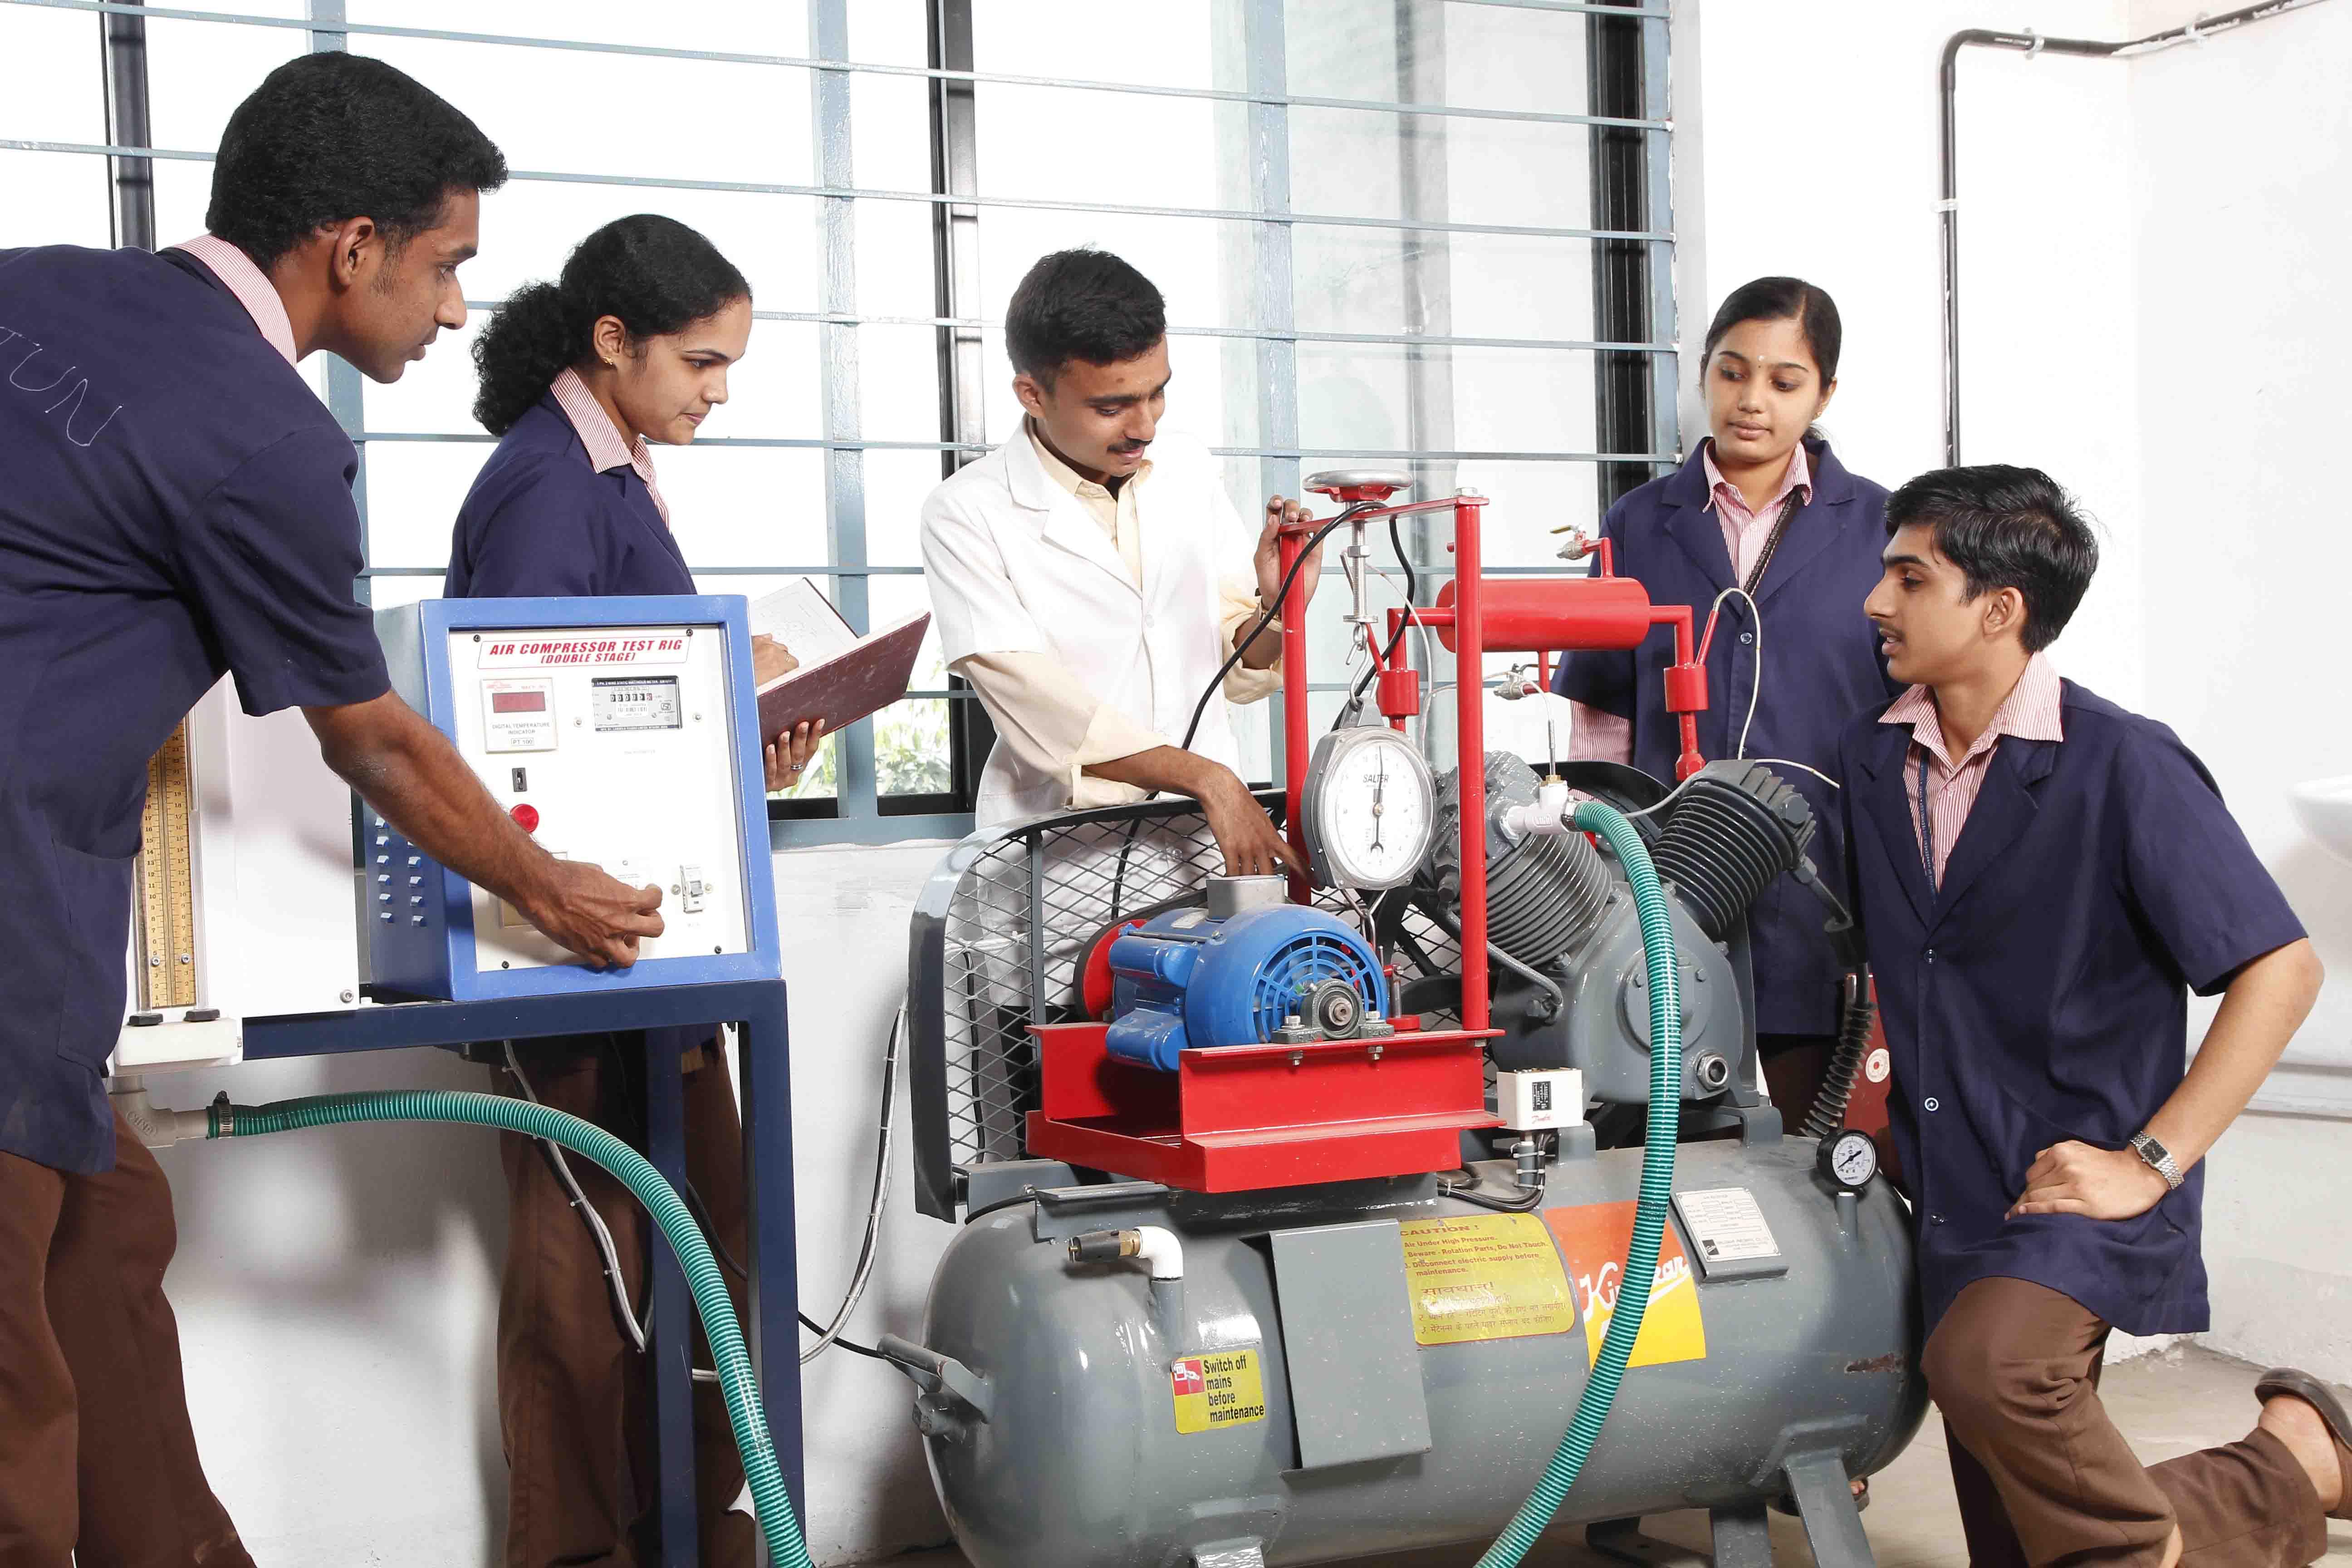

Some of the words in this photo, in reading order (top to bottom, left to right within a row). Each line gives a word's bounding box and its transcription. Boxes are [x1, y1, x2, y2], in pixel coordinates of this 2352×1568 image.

[490, 644, 515, 655] AIR
[519, 641, 615, 655] COMPRESSOR
[622, 640, 654, 652] TEST
[658, 639, 683, 650] RIG
[1362, 774, 1389, 783] SALTER
[1400, 1225, 1470, 1236] CAUTION
[1441, 1238, 1460, 1246] High
[1461, 1235, 1498, 1244] Pressure.
[1442, 1247, 1473, 1255] Rotation
[1412, 1259, 1456, 1269] Disconnect
[1489, 1254, 1514, 1263] supply
[1416, 1267, 1469, 1277] maintenance.
[1203, 1359, 1234, 1374] Switch
[1235, 1355, 1247, 1370] off
[1206, 1376, 1232, 1390] mains
[1208, 1391, 1235, 1406] before
[1210, 1405, 1264, 1423] maintenance
